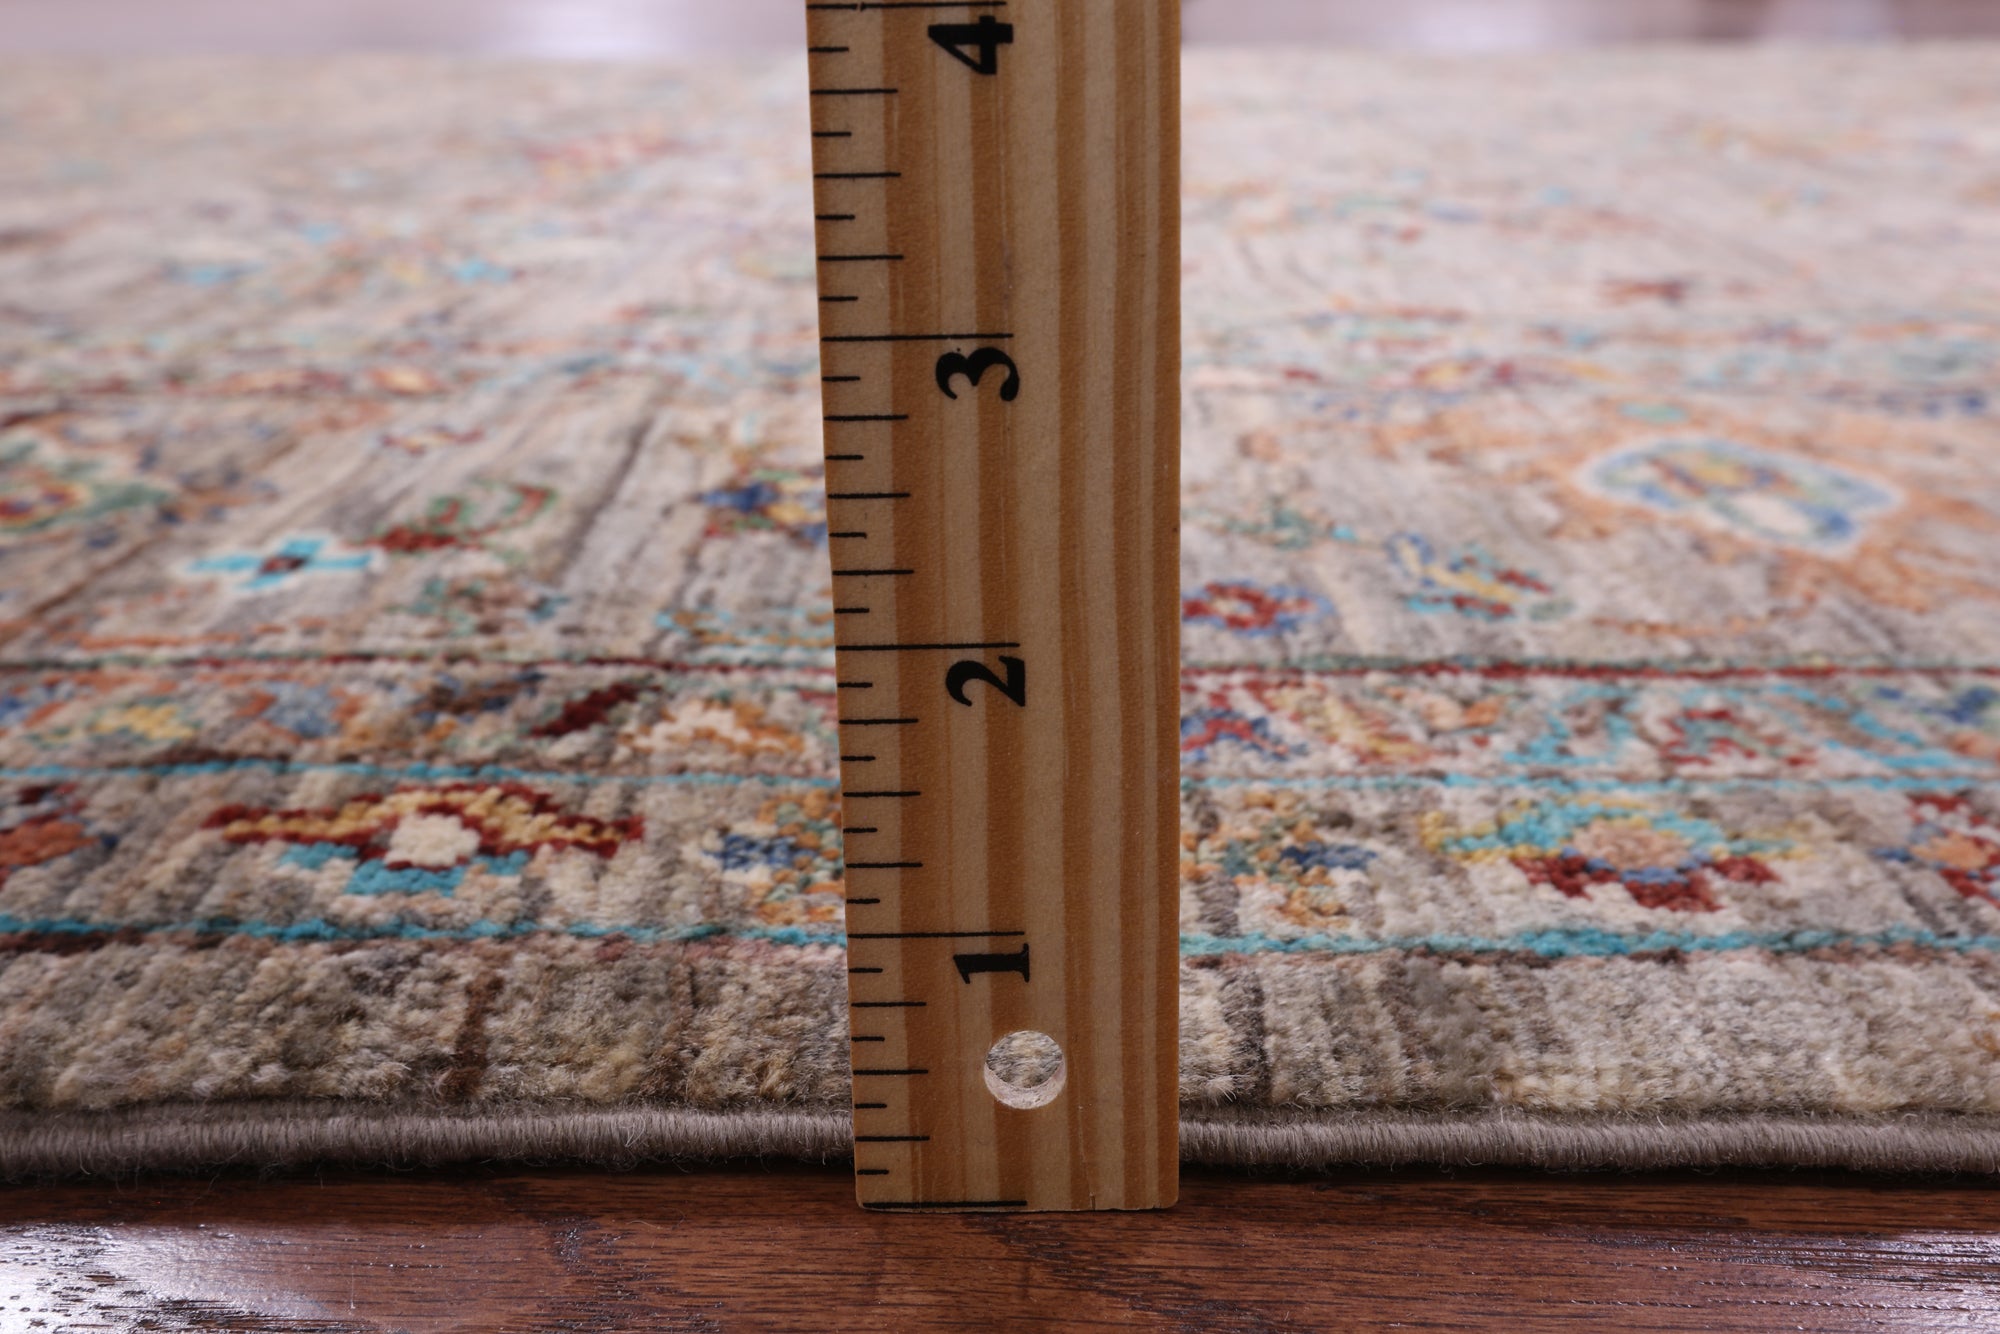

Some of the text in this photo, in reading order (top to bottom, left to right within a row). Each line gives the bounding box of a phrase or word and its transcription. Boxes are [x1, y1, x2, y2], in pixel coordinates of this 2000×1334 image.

[928, 14, 1013, 76] 4
[935, 346, 1020, 402] 3
[945, 655, 1026, 707] 2
[952, 943, 1030, 984] 1
